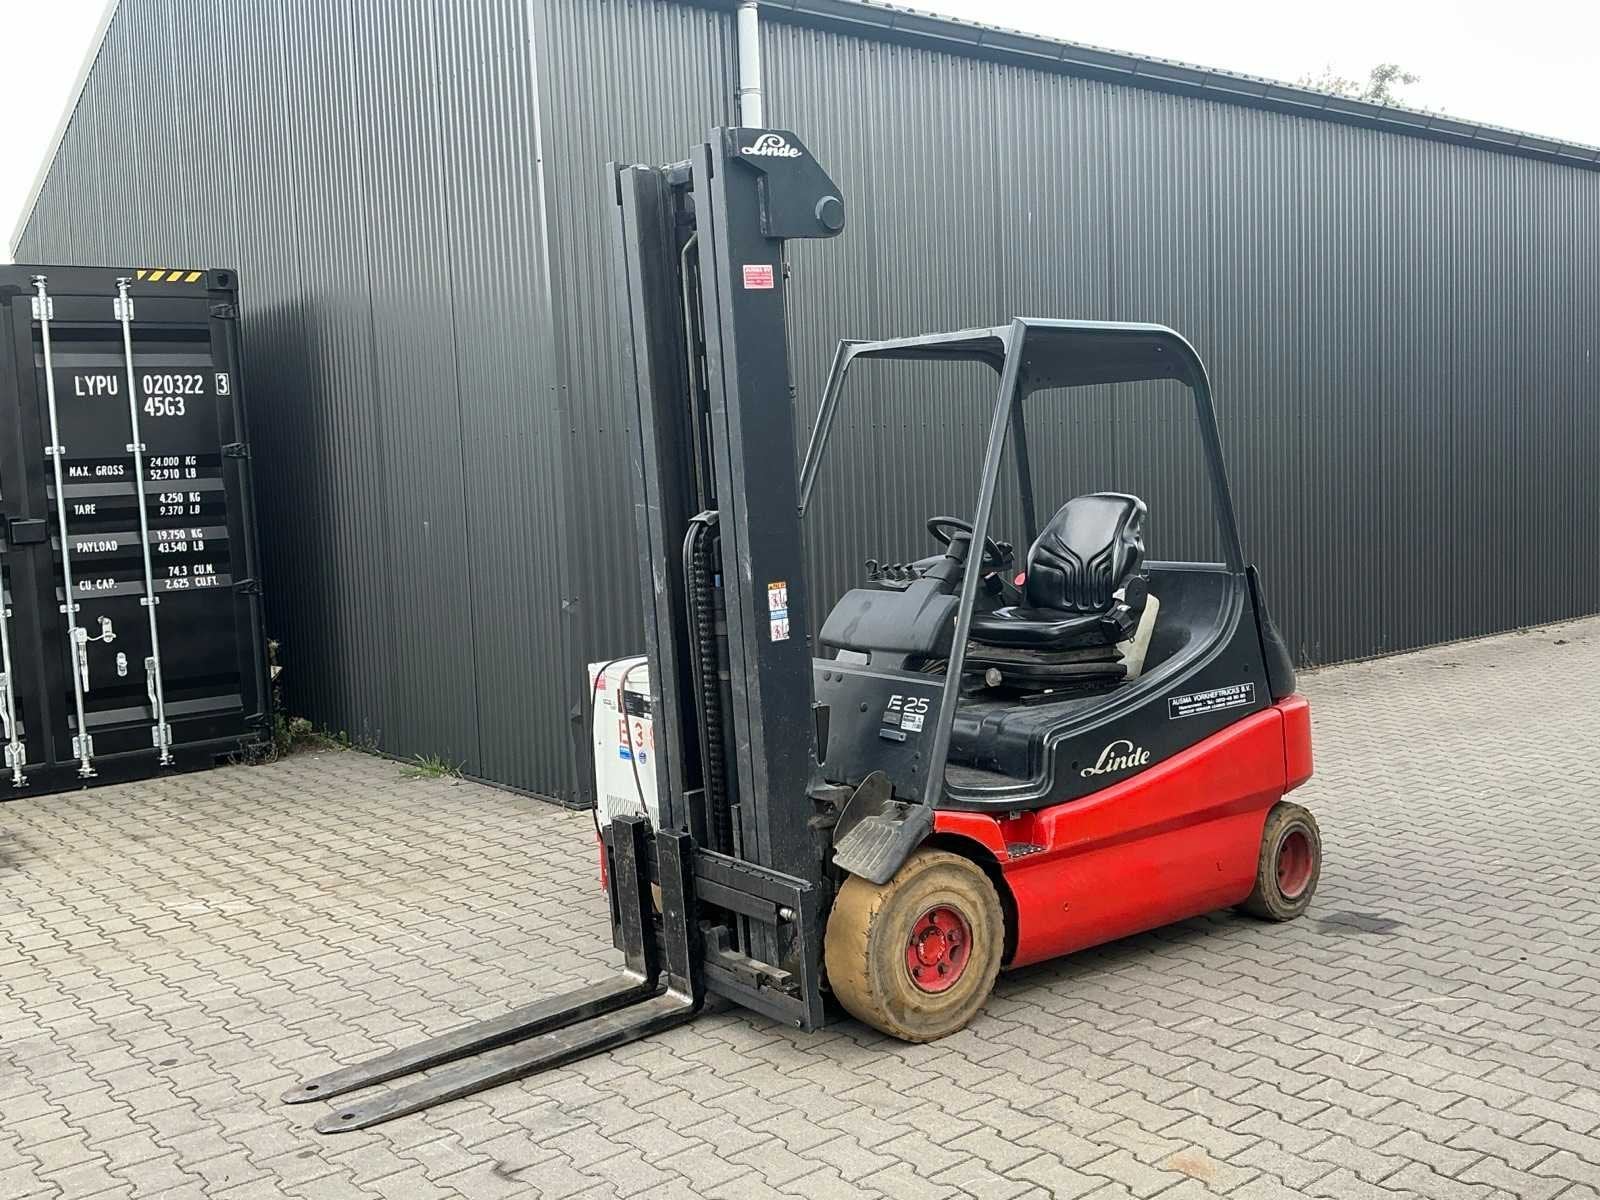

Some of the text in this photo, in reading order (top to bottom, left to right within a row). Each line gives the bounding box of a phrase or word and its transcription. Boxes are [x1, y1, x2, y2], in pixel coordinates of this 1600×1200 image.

[741, 133, 803, 158] Linde
[74, 374, 228, 396] LYPU 020322 3
[144, 396, 185, 416] 45G3
[150, 455, 197, 467] 24.000 KG
[69, 465, 125, 477] MAX. GROSS
[150, 468, 197, 480] 52.910 LB
[159, 492, 200, 504] 4.250 KG
[74, 504, 96, 515] TARE
[159, 504, 200, 516] 9.370 LB
[157, 529, 203, 540] 19.750 KG
[76, 541, 118, 553] PAYLOAD
[158, 541, 204, 553] 43.540 LB
[168, 565, 188, 577] 74.3
[165, 578, 190, 589] 2.625
[887, 694, 930, 713] E 25
[1080, 739, 1151, 778] Linde
